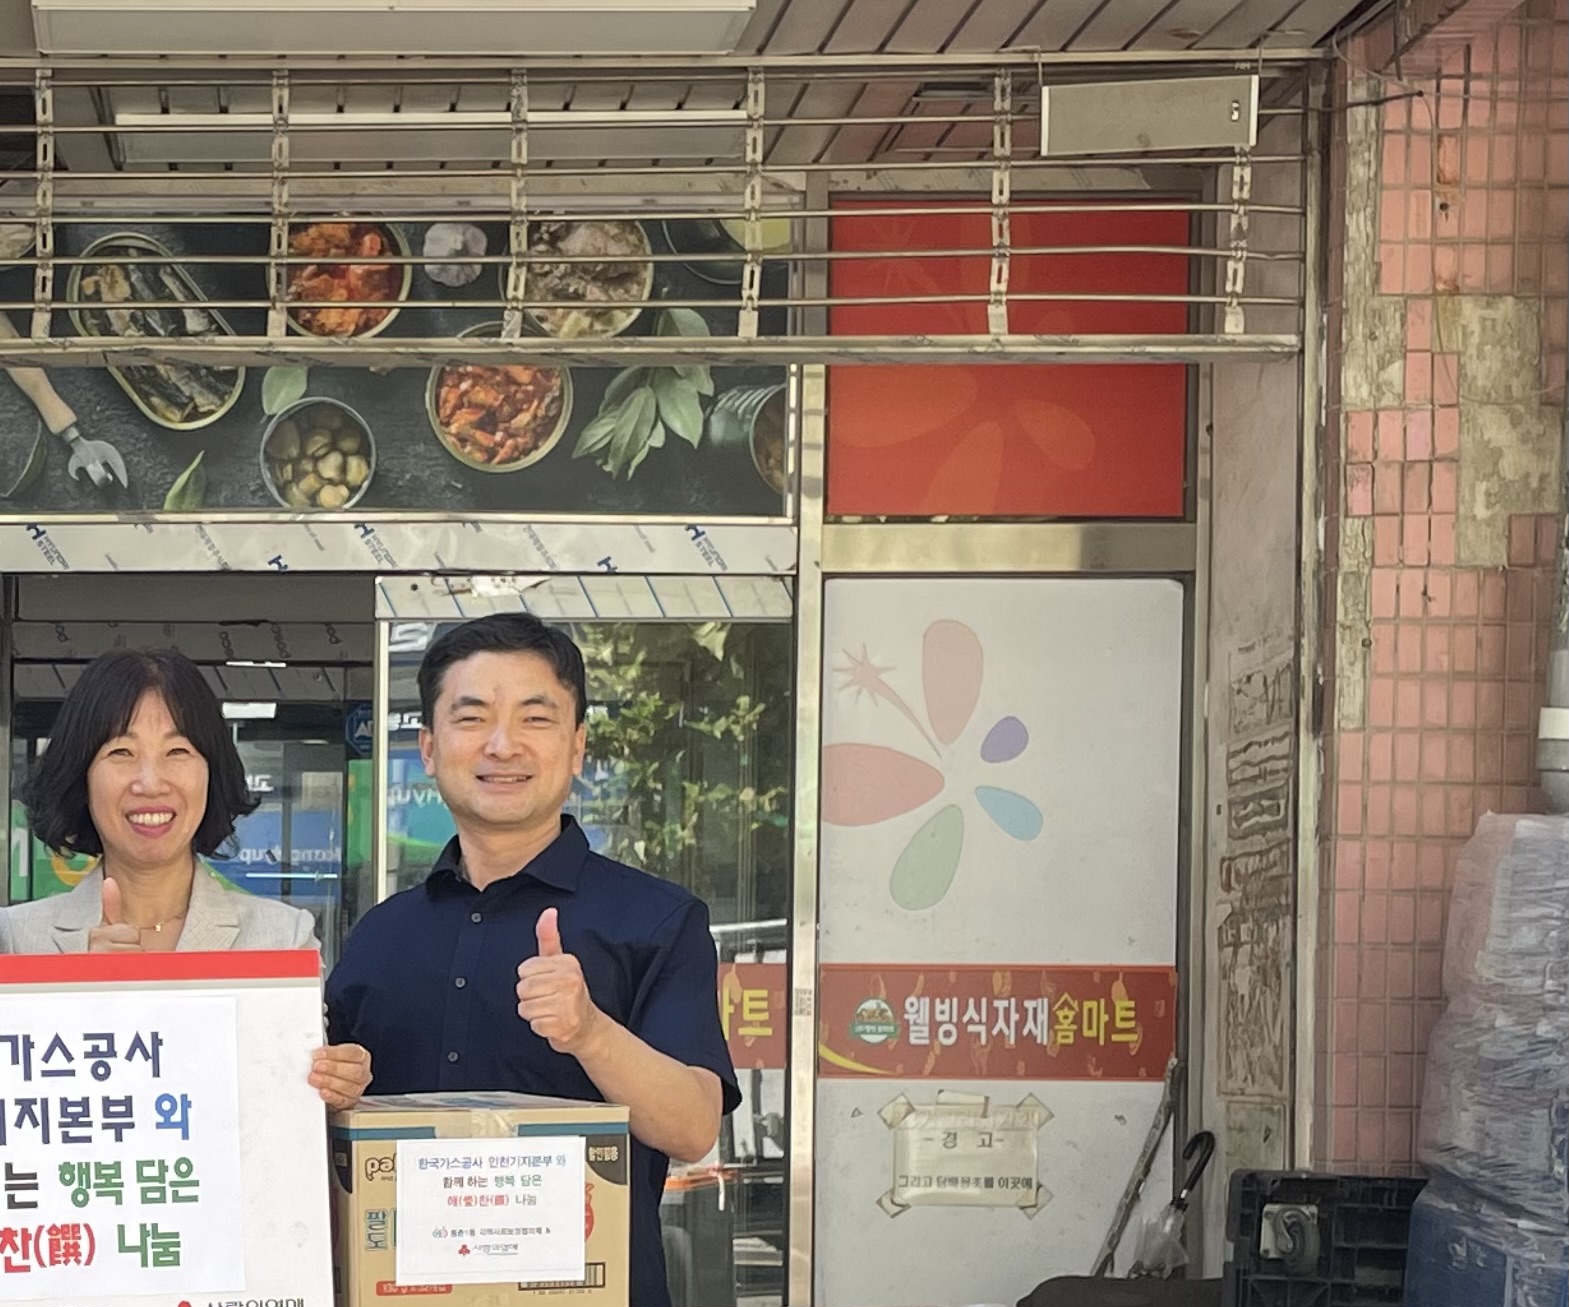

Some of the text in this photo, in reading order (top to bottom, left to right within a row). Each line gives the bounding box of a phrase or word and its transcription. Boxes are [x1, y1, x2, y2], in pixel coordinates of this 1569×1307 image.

[155, 1093, 192, 1140] 와
[58, 1161, 124, 1208] 행복
[136, 1157, 199, 1204] 담은
[418, 1157, 483, 1170] 한국가스공사
[488, 1155, 552, 1168] 인천기지본부
[117, 1223, 181, 1268] 나눔
